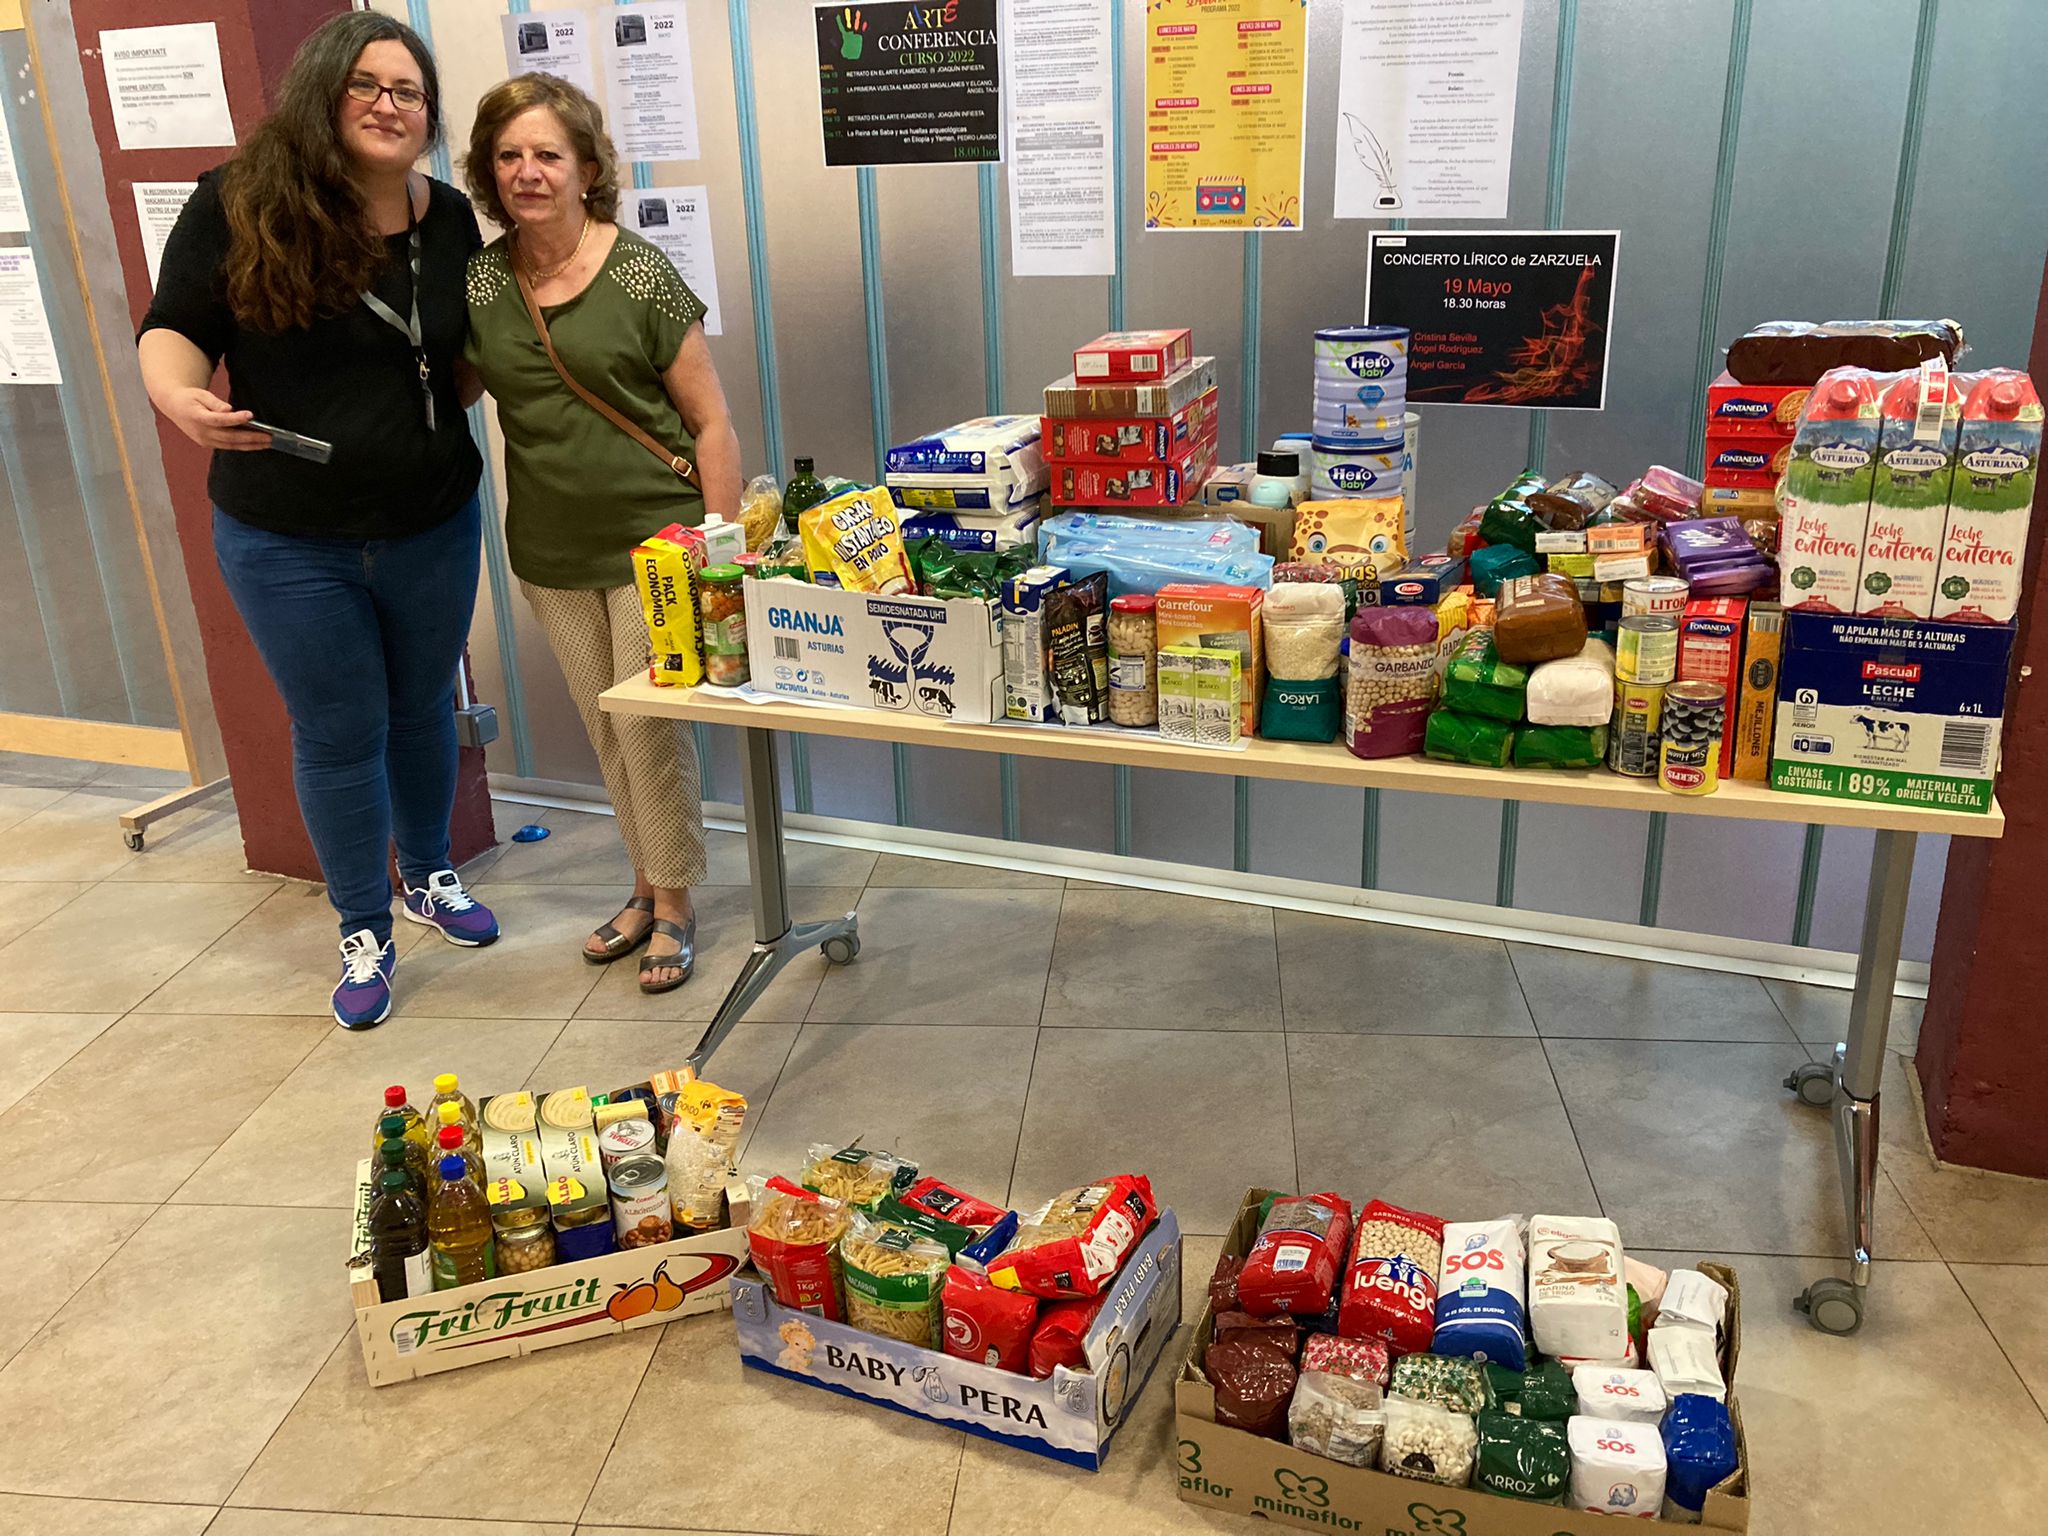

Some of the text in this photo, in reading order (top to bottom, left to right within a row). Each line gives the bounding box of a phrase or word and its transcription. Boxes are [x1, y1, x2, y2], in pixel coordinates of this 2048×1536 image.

[904, 0, 958, 30] ARTE
[1200, 4, 1240, 13] PROGRAMA 2022
[554, 28, 574, 36] 2022
[654, 21, 674, 29] 2022
[878, 29, 997, 51] CONFERENCIA
[114, 48, 167, 59] AVISO IMPORTANTE
[900, 49, 975, 66] CURSO 2022
[846, 70, 870, 78] RETRATO
[870, 69, 878, 77] EN
[937, 64, 960, 73] JOAQUÍN
[961, 64, 985, 72] INFIESTA
[877, 84, 896, 92] VUELTA
[848, 114, 870, 122] RETRATO
[938, 110, 960, 118] JOAQUÍN
[871, 128, 879, 136] de
[880, 128, 894, 136] Saba
[929, 127, 967, 136] arqueológicas
[911, 135, 930, 144] Etiopía
[957, 134, 975, 142] PEDRO
[976, 133, 997, 141] LAVADO
[953, 146, 980, 158] 18.00
[1383, 251, 1601, 266] CONCIERTO LÍRICO de ZARZUELA
[1443, 279, 1512, 297] 19 Mayo
[1443, 298, 1506, 309] 18.30 horas
[1414, 333, 1477, 342] Cristina Sevilla
[1351, 354, 1390, 369] Hero
[1360, 368, 1384, 378] Baby
[1339, 404, 1347, 427] 1
[1722, 403, 1768, 413] FONTANEDA
[1720, 454, 1764, 464] FONTANEDA
[1813, 453, 1866, 465] ASTURIANA
[1887, 454, 1943, 468] ASTURIANA
[1966, 456, 2024, 469] ASTURIANA
[1333, 468, 1372, 481] Hero
[1340, 479, 1366, 490] Baby
[831, 499, 873, 531] CACAO
[1796, 516, 1828, 534] Leche
[1870, 521, 1904, 539] Leche
[1948, 524, 1984, 543] Leche
[1794, 533, 1859, 558] entera
[1868, 539, 1936, 562] entera
[1946, 541, 2016, 566] entera
[853, 555, 869, 571] EN
[646, 559, 665, 628] ECONÓMICO
[662, 576, 677, 606] PACK
[682, 552, 703, 632] ECONÓMICO
[1358, 591, 1376, 603] 10
[868, 603, 945, 620] SEMIDESNATADA UHT
[1158, 599, 1213, 612] Carrefour
[768, 607, 844, 637] GRANJA
[1051, 623, 1079, 636] PALADIN
[1689, 622, 1731, 633] FONTANEDA
[1832, 624, 1966, 643] NO APILAR MÁS DE 5 ALTURAS
[807, 641, 844, 654] ASTURIAS
[1839, 635, 1956, 651] NÃO EMPILHAR MAIS DE 5 ALTURAS
[1375, 658, 1434, 673] GARBANZO
[1866, 664, 1917, 678] Pascual
[1863, 684, 1915, 698] LECHE
[1279, 693, 1320, 705] LARGO
[1871, 695, 1904, 703] ENTERA
[1751, 701, 1764, 757] MEJILLONES
[1802, 740, 1808, 749] B
[1853, 753, 1885, 761] BIENESTAR
[1667, 769, 1700, 783] SERPIS
[1788, 765, 1824, 779] ENVASE
[1777, 775, 1832, 791] SOSTENIBLE
[1849, 773, 1890, 796] 89%
[1907, 778, 1975, 795] MATERIAL DE
[1896, 788, 1982, 806] ORIGEN VEGETAL
[510, 1135, 520, 1156] CLARO
[568, 1131, 578, 1155] CLARO
[498, 1177, 511, 1205] ALBO
[558, 1176, 572, 1205] ALBO
[941, 1198, 961, 1213] GALLO
[1372, 1211, 1411, 1224] GARBANZO
[1446, 1249, 1504, 1274] SOS
[1114, 1253, 1154, 1316] BABY PERA
[1353, 1271, 1436, 1315] luengo
[1482, 1307, 1506, 1315] BUENO
[825, 1344, 1048, 1430] BABY PERA
[1602, 1384, 1640, 1397] SOS
[1596, 1439, 1636, 1454] SOS
[1180, 1476, 1233, 1499] aflor
[1484, 1473, 1536, 1495] ARROZ
[1253, 1495, 1363, 1532] mimaflor
